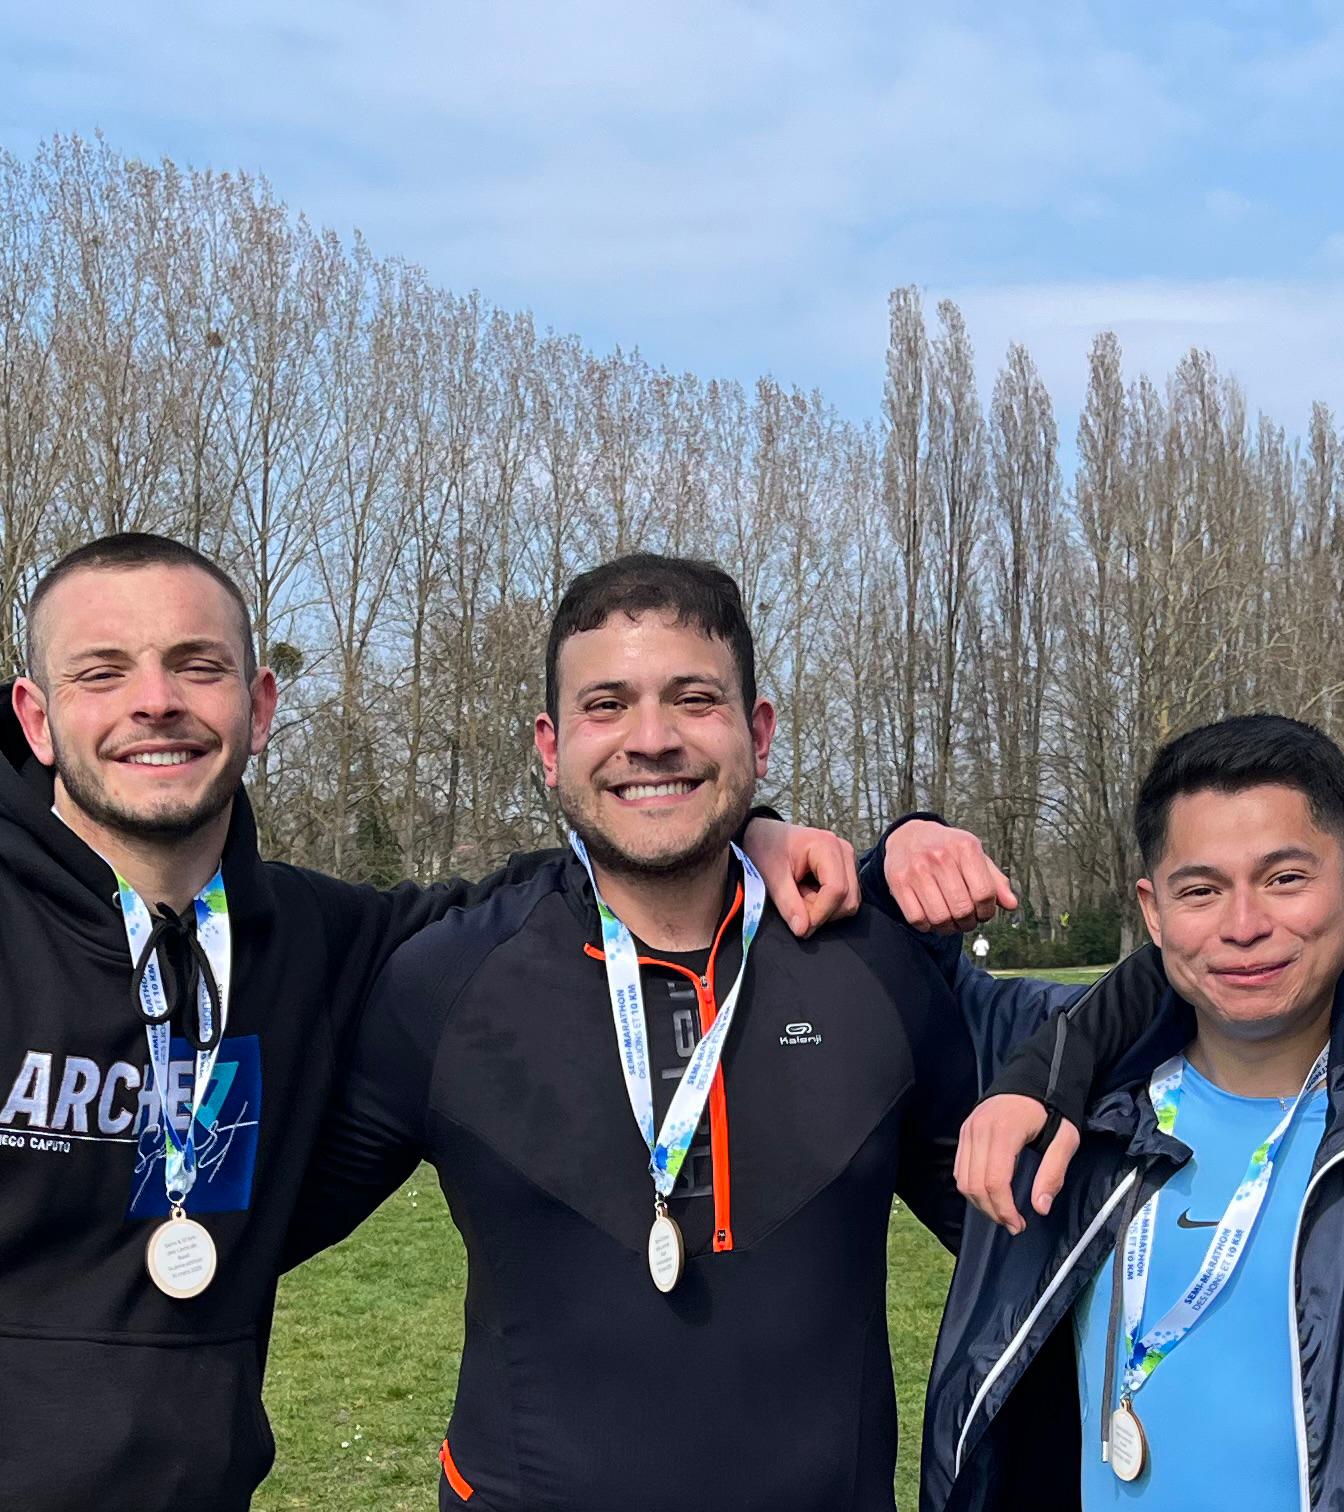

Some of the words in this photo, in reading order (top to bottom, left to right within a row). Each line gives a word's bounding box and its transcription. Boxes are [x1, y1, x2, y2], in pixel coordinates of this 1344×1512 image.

[147, 963, 157, 981] KM
[627, 984, 637, 1001] KM
[630, 1002, 639, 1015] 10
[616, 989, 636, 1077] SEMI-MARATHON
[29, 1137, 71, 1154] CAPUTO
[1231, 1229, 1244, 1246] KM
[1226, 1246, 1237, 1258] 10
[1126, 1264, 1134, 1280] KM
[1184, 1228, 1232, 1305] SEMI-MARATHON
[1203, 1271, 1226, 1297] LIONS
[1192, 1295, 1208, 1312] DES
